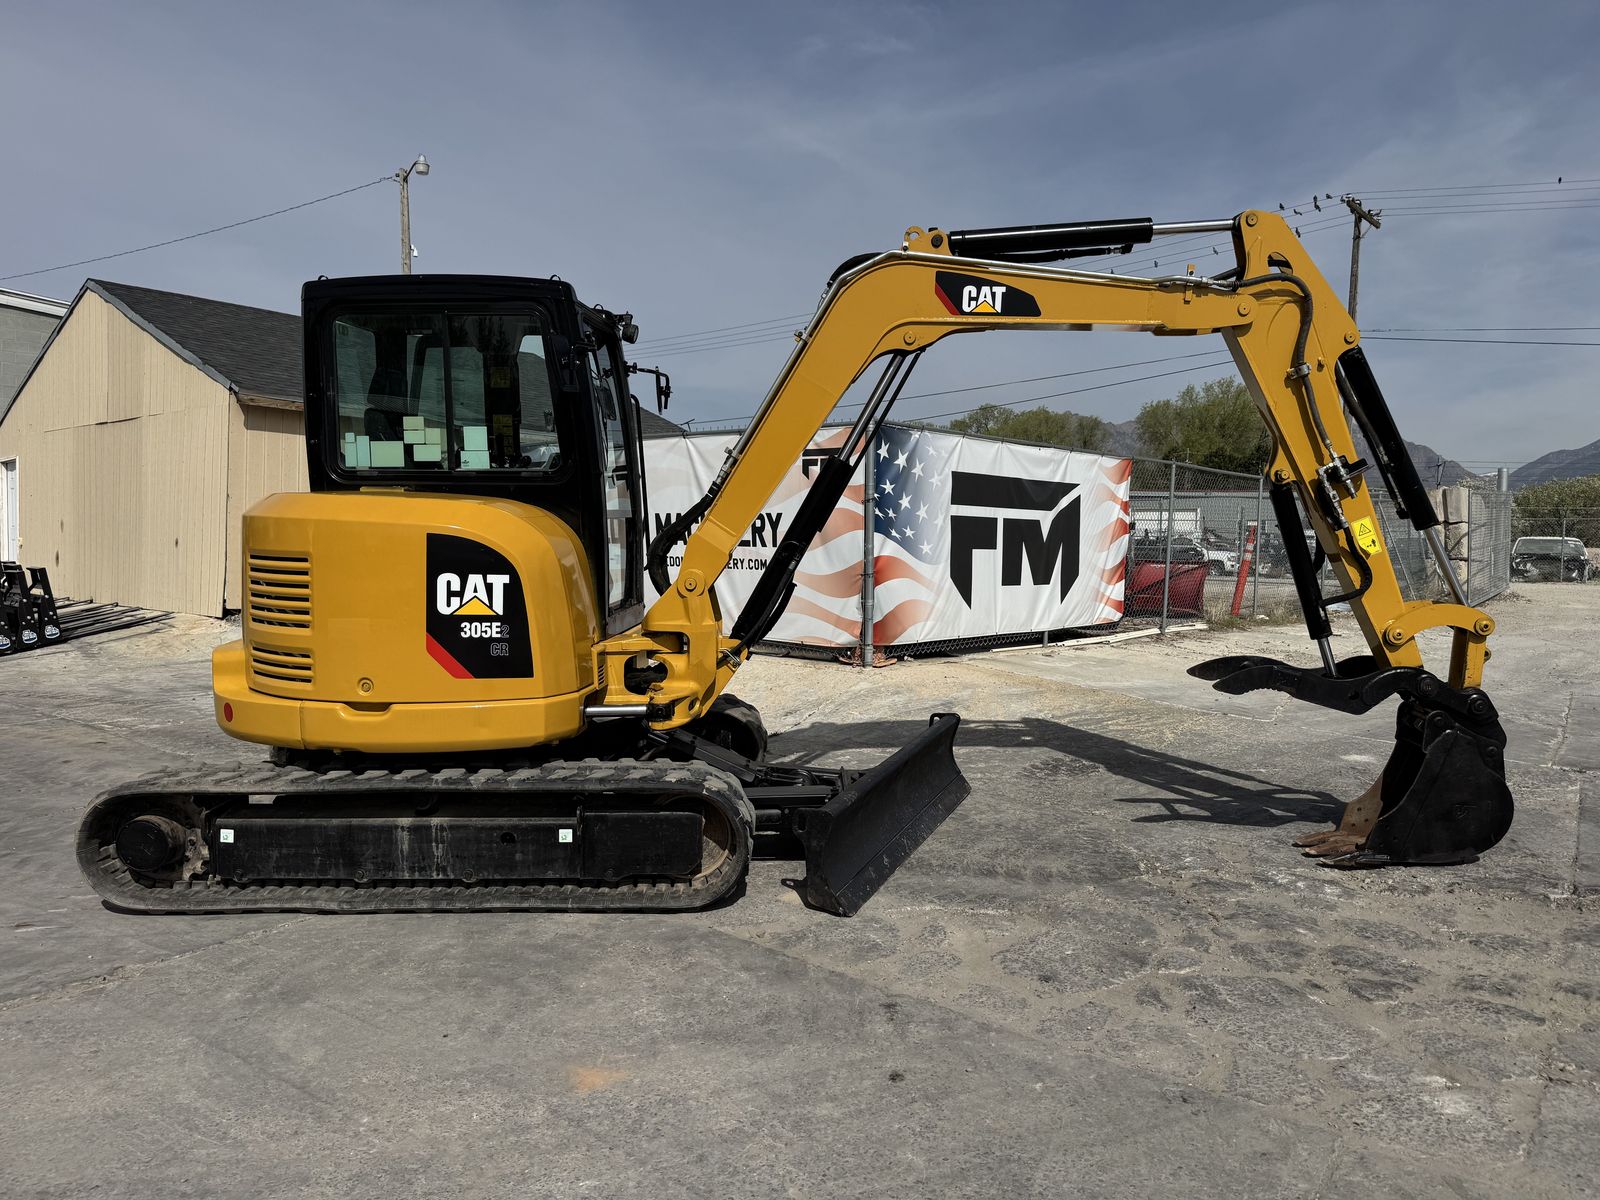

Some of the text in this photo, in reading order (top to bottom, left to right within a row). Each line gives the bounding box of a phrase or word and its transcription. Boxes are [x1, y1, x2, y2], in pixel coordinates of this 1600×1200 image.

[962, 285, 1006, 313] CAT
[950, 471, 1081, 610] FM
[437, 573, 510, 615] CAT
[460, 621, 509, 638] 305E2
[490, 642, 509, 656] CR
